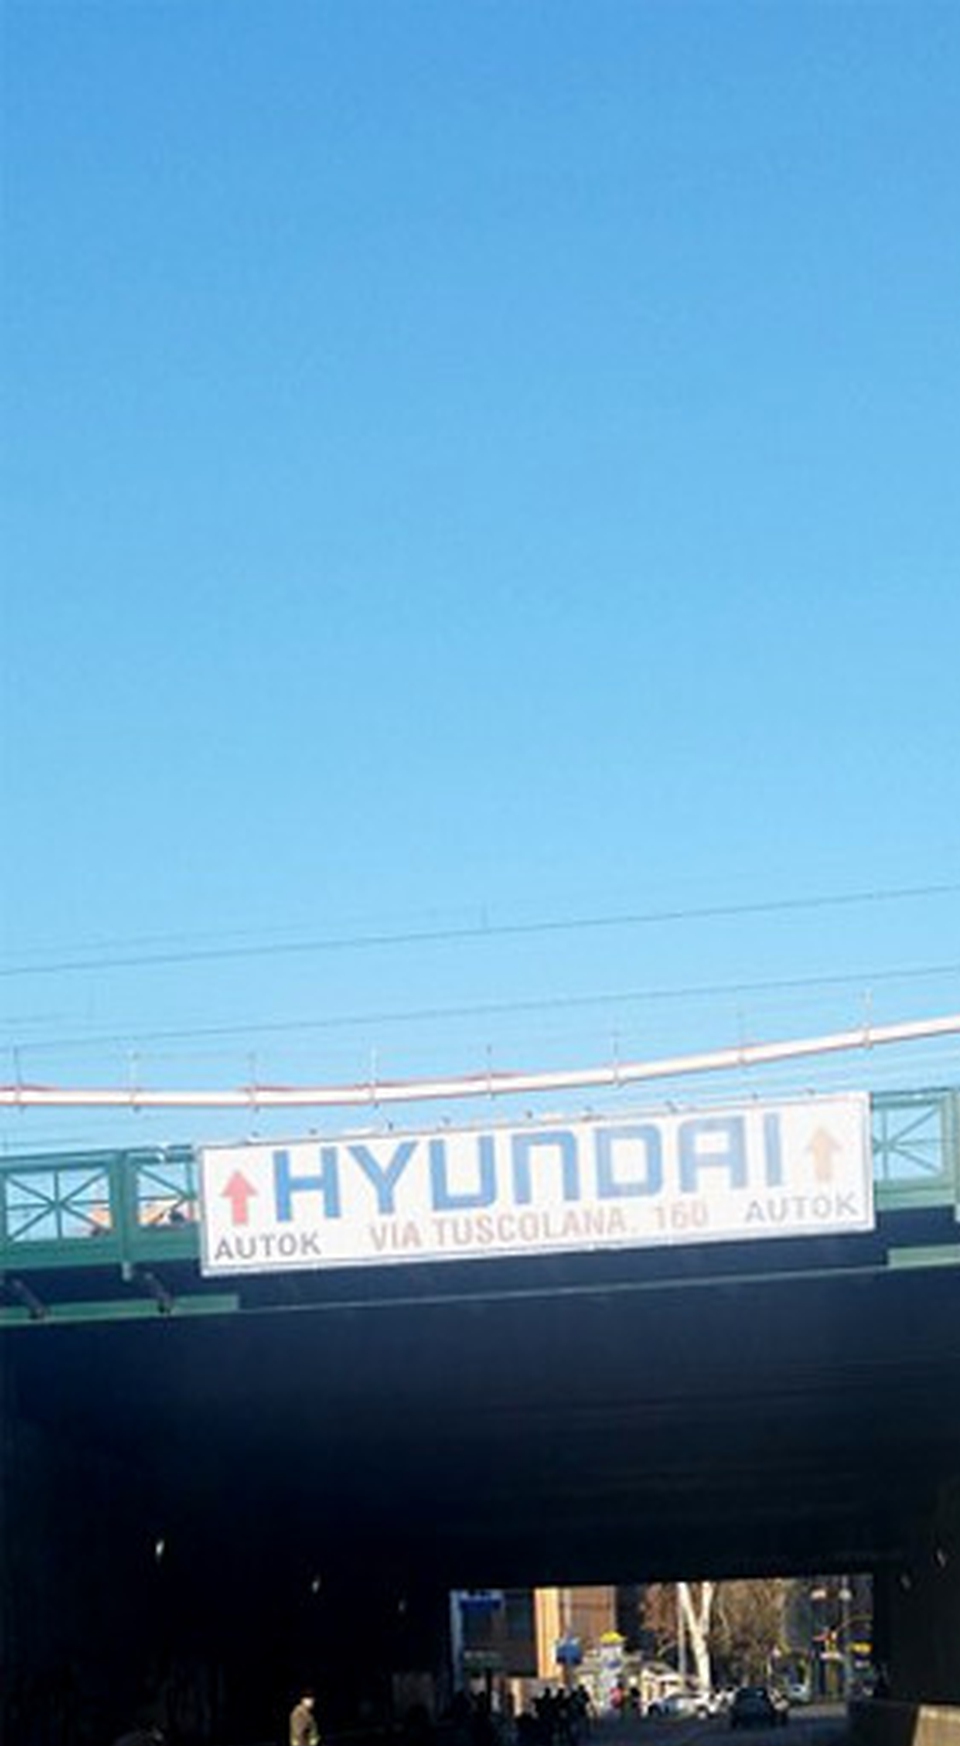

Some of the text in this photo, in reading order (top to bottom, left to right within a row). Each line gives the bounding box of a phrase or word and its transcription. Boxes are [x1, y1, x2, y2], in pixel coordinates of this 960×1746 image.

[271, 1113, 783, 1223] HYUNDAI
[370, 1220, 421, 1251] VIA
[654, 1200, 709, 1230] 160
[745, 1192, 858, 1223] AUTOK
[214, 1231, 321, 1261] AUTOK
